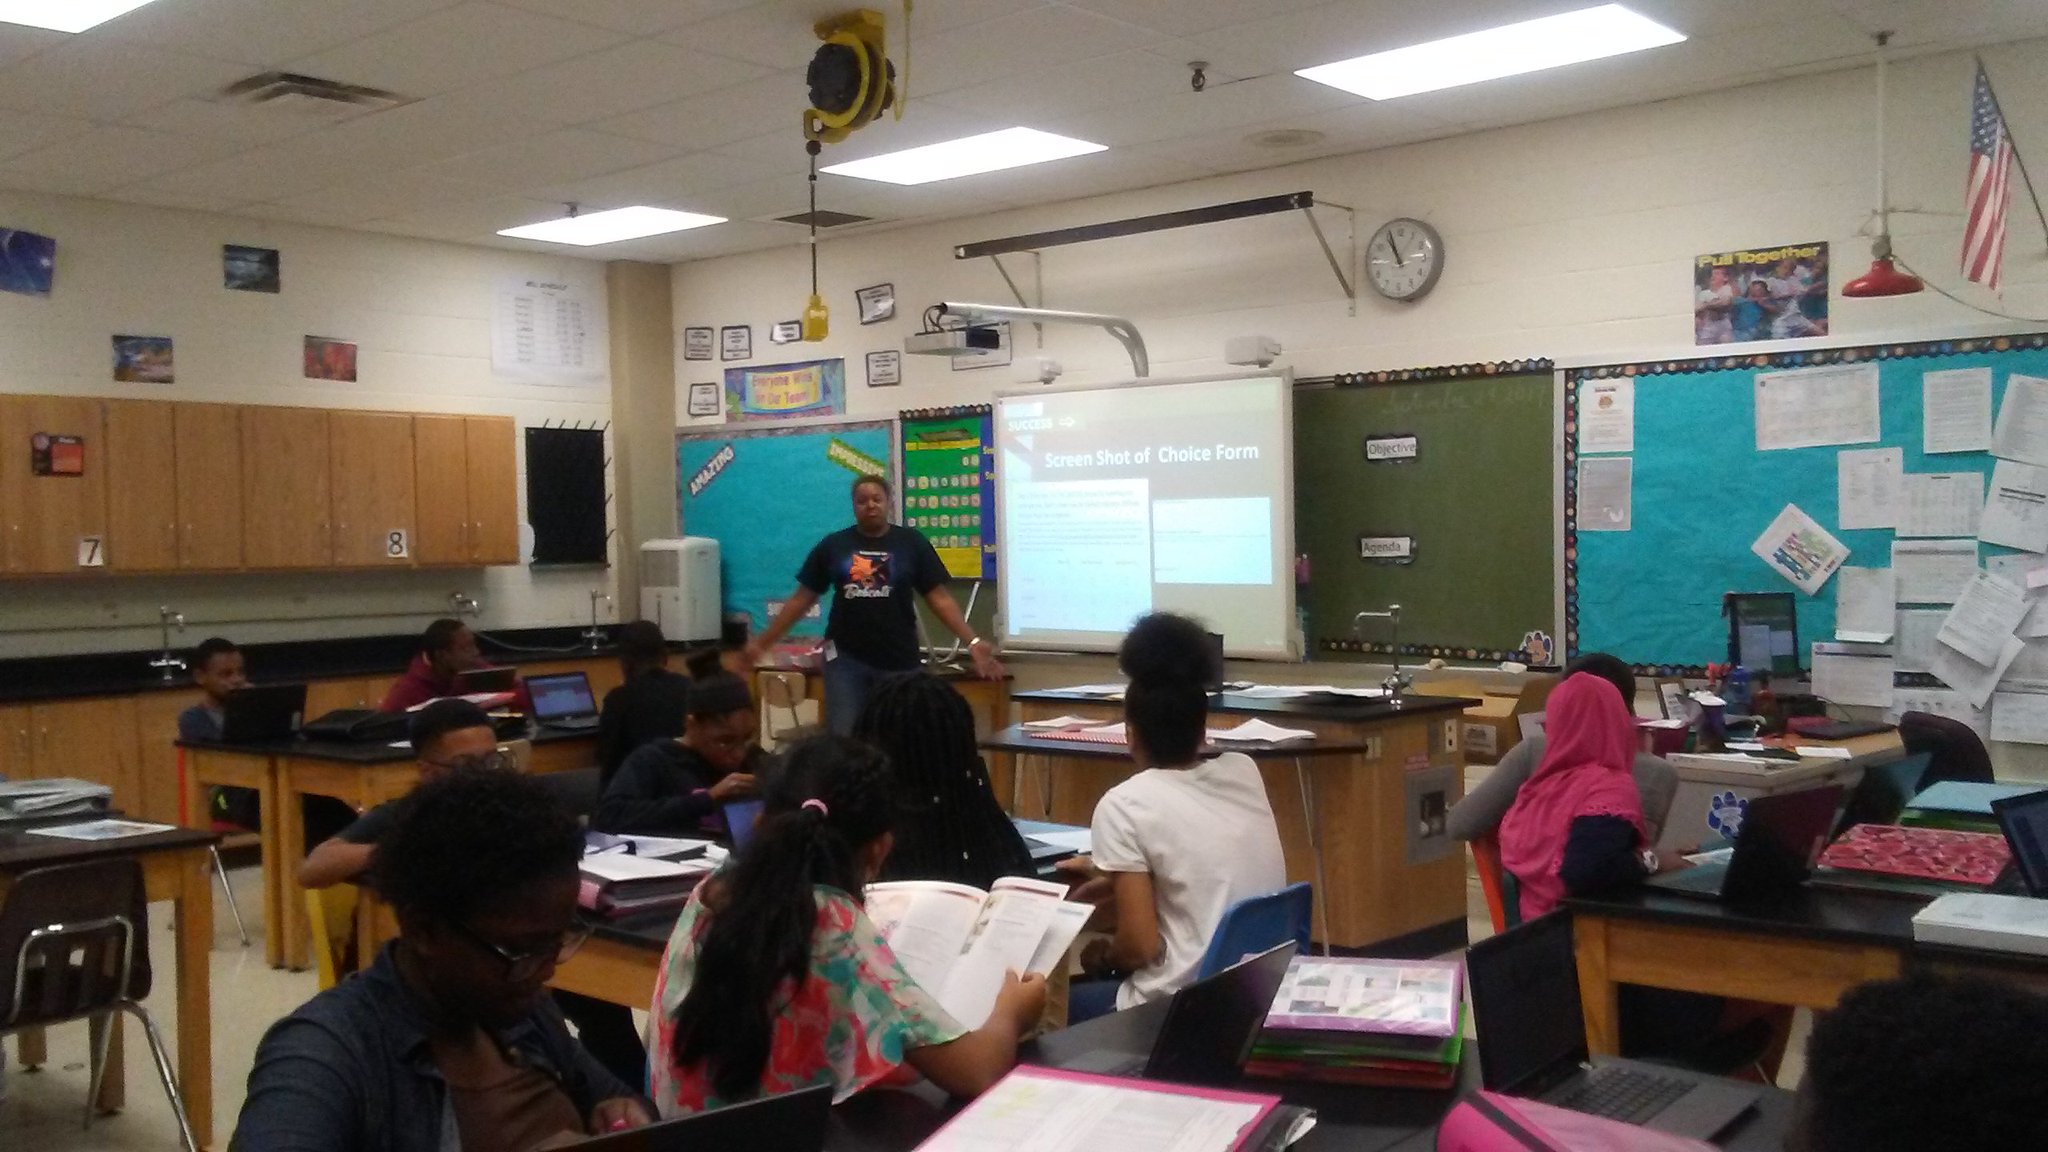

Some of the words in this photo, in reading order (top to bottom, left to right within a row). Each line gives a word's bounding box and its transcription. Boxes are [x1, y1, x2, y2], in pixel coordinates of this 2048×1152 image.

[1698, 253, 1733, 267] Pull
[1735, 246, 1820, 264] Together
[1008, 418, 1053, 433] SUCCESS
[1045, 452, 1093, 468] Screen
[1096, 449, 1131, 466] Shot
[1134, 447, 1151, 464] of
[1158, 446, 1212, 463] Choice
[1215, 444, 1260, 461] Form
[1368, 443, 1416, 456] Objective
[689, 445, 735, 496] AMAZING
[83, 538, 100, 564] 7
[389, 531, 404, 556] 8
[1363, 542, 1401, 556] Agenda
